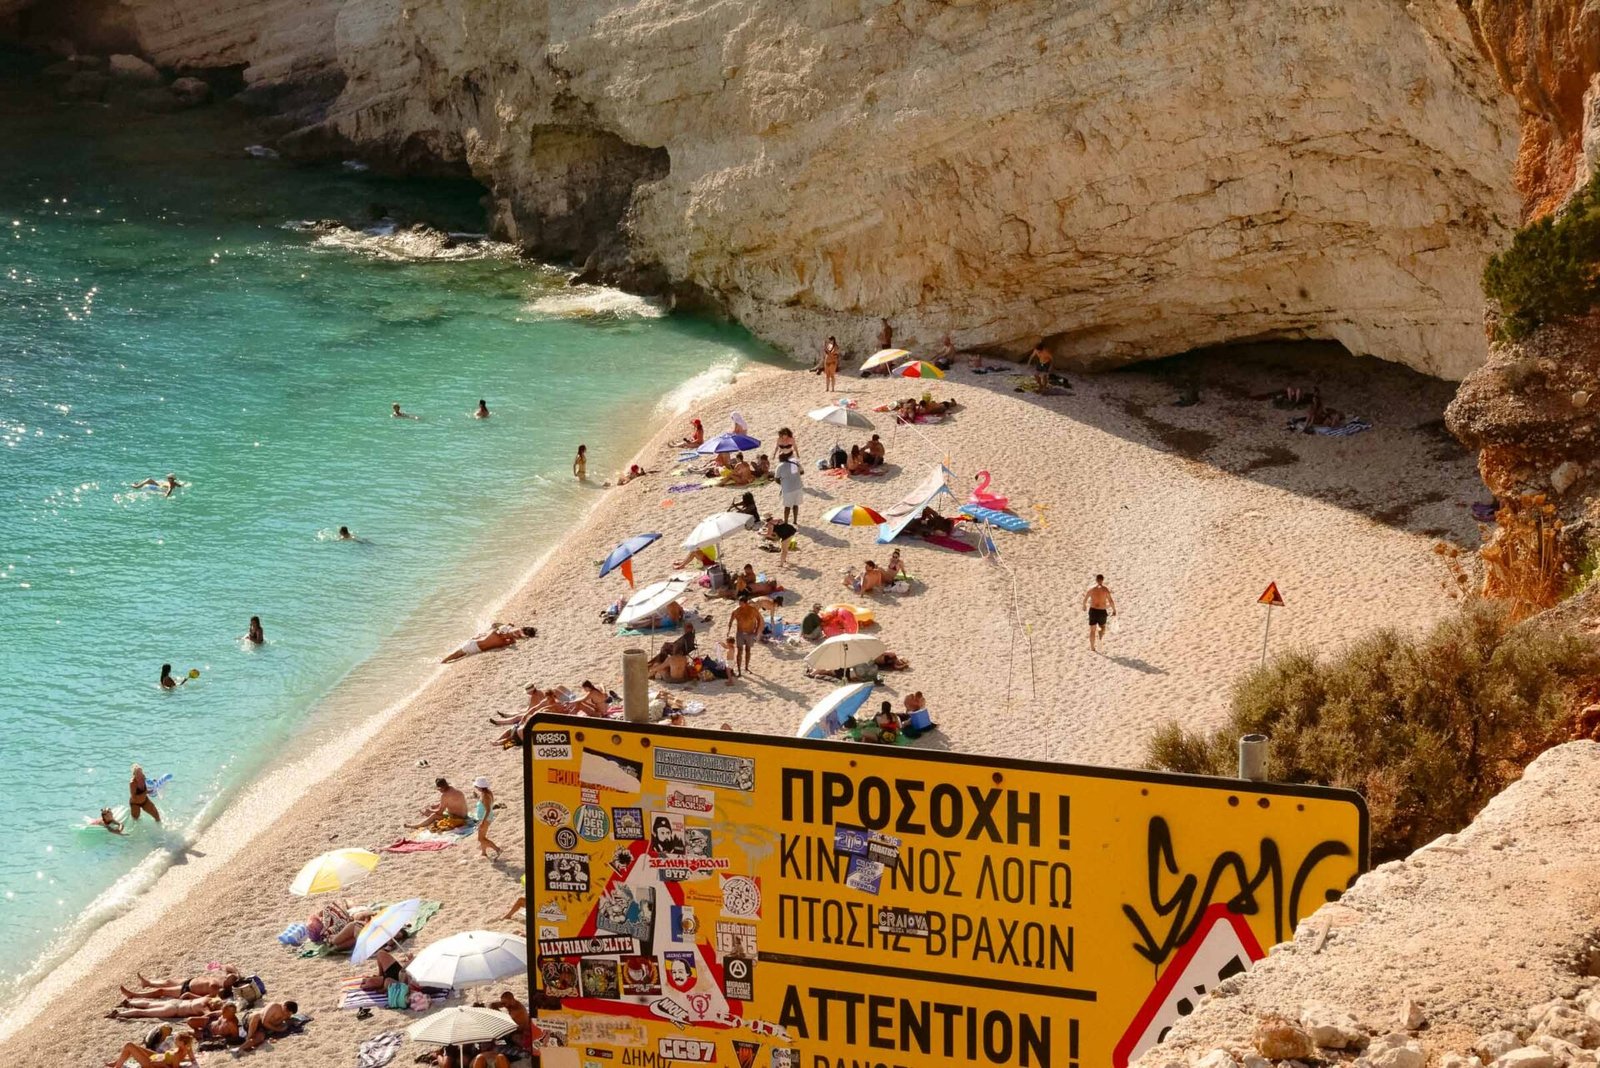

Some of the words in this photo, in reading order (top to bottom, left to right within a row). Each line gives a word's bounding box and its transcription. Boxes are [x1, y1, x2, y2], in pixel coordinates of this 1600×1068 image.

[584, 809, 605, 820] NUR
[781, 767, 1041, 847] ΠΡΟΣΟΧΗ
[583, 817, 604, 828] DER
[545, 853, 589, 863] FAMAGUSTA
[780, 833, 963, 898] ΚΙΝΝΟΣ
[976, 854, 1073, 909] ΛΟΓΩ
[549, 881, 587, 891] GHETTO
[716, 922, 757, 936] LIBERATION
[879, 911, 929, 930] CRAIOVA
[540, 940, 590, 956] ILLYRIAN
[603, 937, 632, 952] ELITE
[926, 910, 1075, 972] ΒΡΑΧΩΝ
[659, 998, 689, 1018] NIQUE
[778, 984, 1051, 1068] ATTENTION
[659, 1039, 714, 1062] CC97
